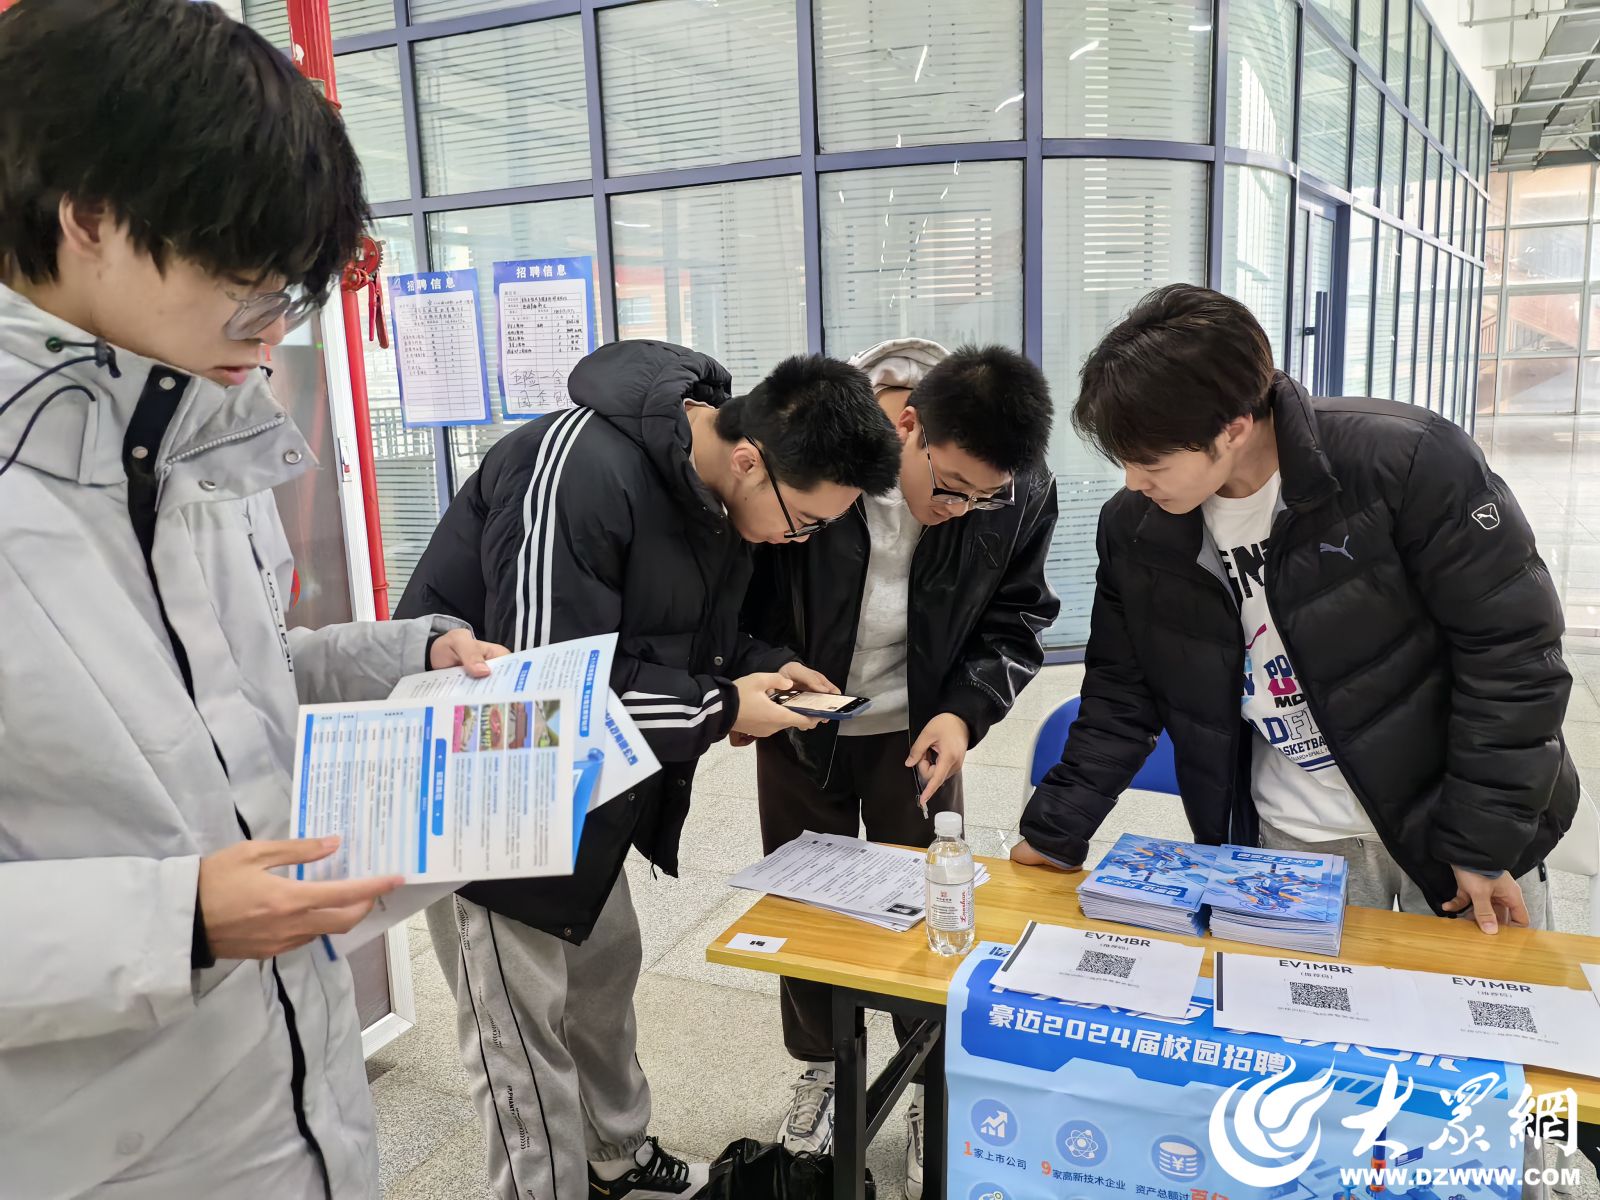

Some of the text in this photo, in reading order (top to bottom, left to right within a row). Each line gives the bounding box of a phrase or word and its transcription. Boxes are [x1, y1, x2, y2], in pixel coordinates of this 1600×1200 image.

[516, 263, 567, 279] 招聘信息
[407, 277, 456, 292] 招聘信息
[1084, 931, 1151, 948] EV1MBR
[1279, 959, 1354, 974] EV1MBR
[1451, 976, 1533, 993] EV1MBR
[988, 1003, 1287, 1077] 豪迈2024届校园招聘
[963, 1141, 1027, 1170] 1家上市公司
[1041, 1160, 1126, 1190] 9家高新技术企业
